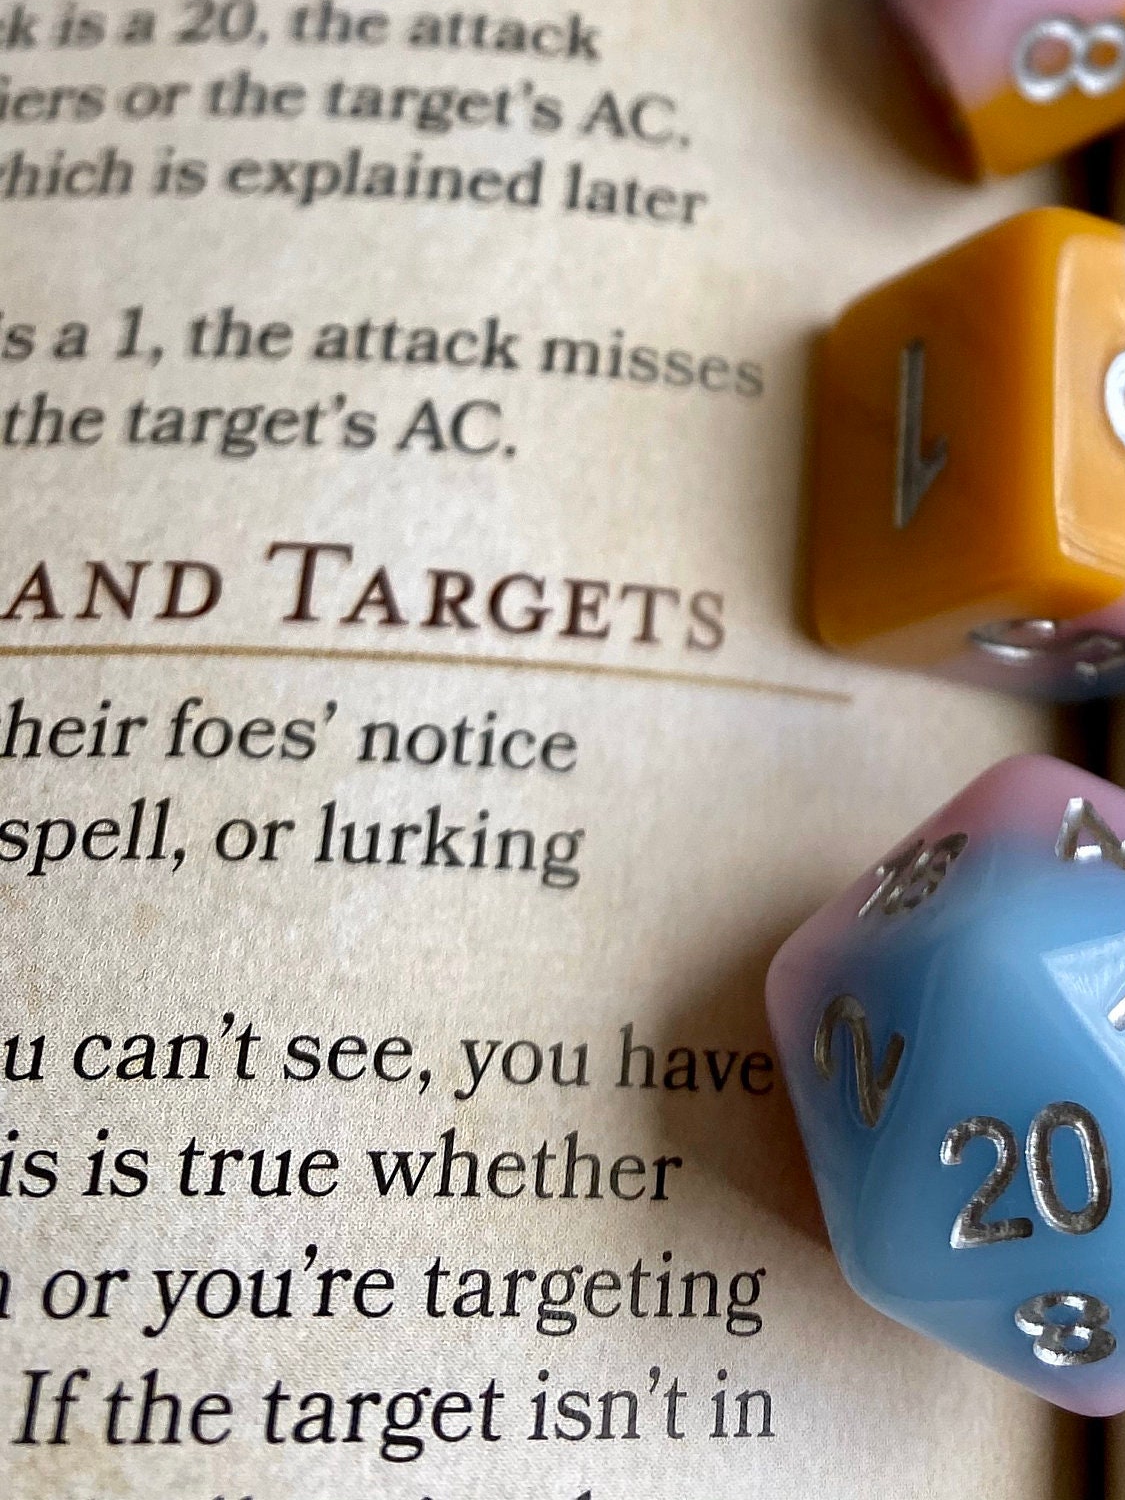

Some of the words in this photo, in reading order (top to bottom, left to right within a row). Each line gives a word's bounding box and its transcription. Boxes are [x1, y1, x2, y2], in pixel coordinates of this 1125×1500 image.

[408, 11, 602, 62] attack
[207, 68, 307, 121] the
[325, 78, 564, 136] target's
[580, 91, 691, 149] AC.
[154, 146, 207, 197] is
[225, 146, 546, 212] explained
[565, 161, 710, 224] later
[116, 306, 165, 364] 1,
[184, 310, 294, 364] the
[315, 317, 520, 373] attack
[540, 331, 767, 401] misses
[1, 394, 105, 448] the
[127, 394, 378, 461] target's
[399, 396, 520, 460] AC.
[894, 337, 949, 530] 1
[1, 559, 223, 621] AND
[267, 540, 727, 653] TARGETS
[0, 698, 147, 759] heir
[167, 696, 338, 761] foes'
[358, 710, 579, 772] notice
[0, 797, 187, 876] spell,
[216, 815, 296, 862] or
[316, 799, 586, 890] lurking
[73, 1010, 261, 1083] can't
[282, 1034, 433, 1097] see,
[454, 1037, 591, 1101] you
[615, 1021, 776, 1097] have
[814, 995, 905, 1128] 2
[82, 1128, 149, 1199] is
[178, 1137, 339, 1199] true
[371, 1128, 684, 1204] whether
[940, 1102, 1112, 1249] 20
[44, 1266, 129, 1320] or
[142, 1242, 397, 1340] you're
[423, 1252, 766, 1338] targeting
[1013, 1290, 1117, 1367] 8
[13, 1368, 91, 1447] If
[104, 1368, 234, 1449] the
[262, 1377, 504, 1464] target
[528, 1365, 689, 1446] isn't
[709, 1370, 776, 1442] in
